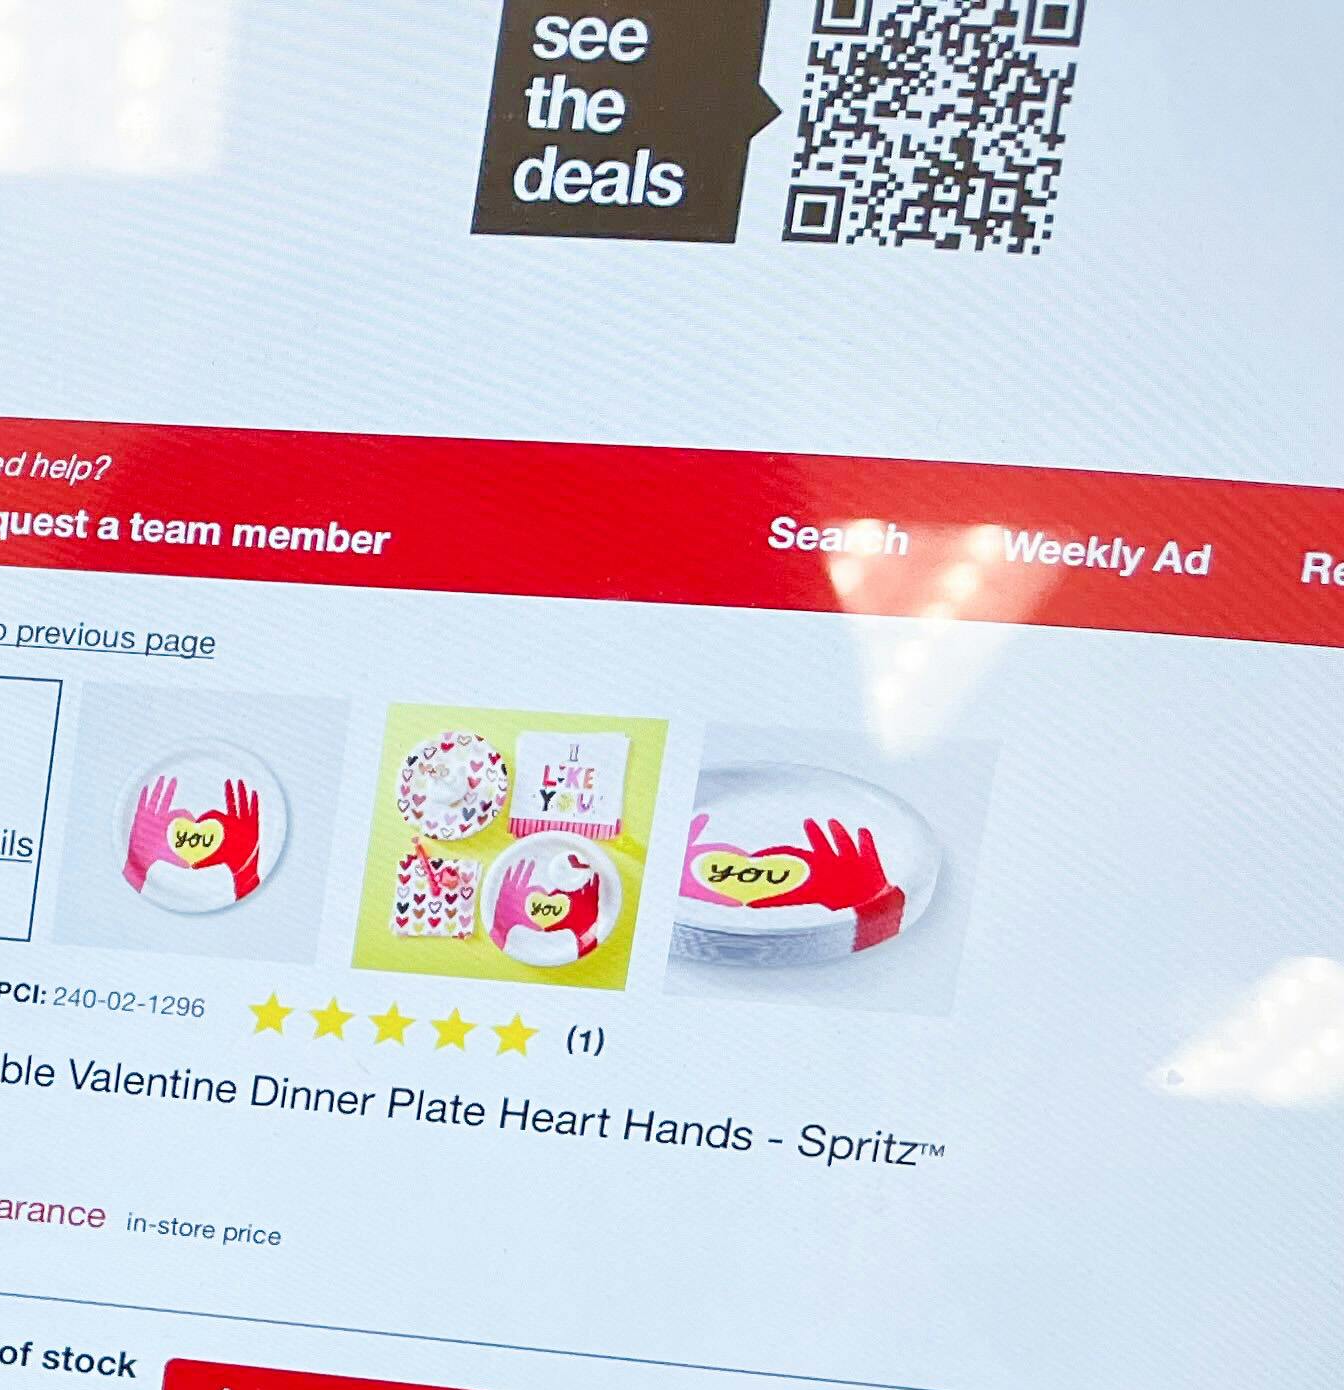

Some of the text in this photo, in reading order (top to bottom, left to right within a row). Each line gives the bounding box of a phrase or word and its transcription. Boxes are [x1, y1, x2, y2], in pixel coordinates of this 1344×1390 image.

[532, 14, 649, 61] see
[525, 75, 625, 133] the
[512, 147, 684, 208] deals
[31, 452, 111, 486] help?
[97, 517, 120, 541] a
[129, 514, 220, 546] team
[232, 522, 391, 556] member
[1003, 531, 1144, 577] Weekly
[1153, 541, 1212, 576] Ad
[15, 621, 135, 650] previous
[145, 633, 216, 657] page
[174, 827, 214, 850] you
[708, 861, 790, 886] you
[53, 986, 205, 1018] 240-02-1296
[566, 1024, 605, 1056] (1)
[69, 1058, 237, 1104] Valentine
[250, 1075, 376, 1116] Dinner
[388, 1086, 486, 1126] Plate
[499, 1097, 610, 1138] Heart
[623, 1109, 753, 1152] Hands
[126, 1211, 216, 1242] in-store
[222, 1225, 282, 1248] price
[42, 1346, 137, 1378] stock
